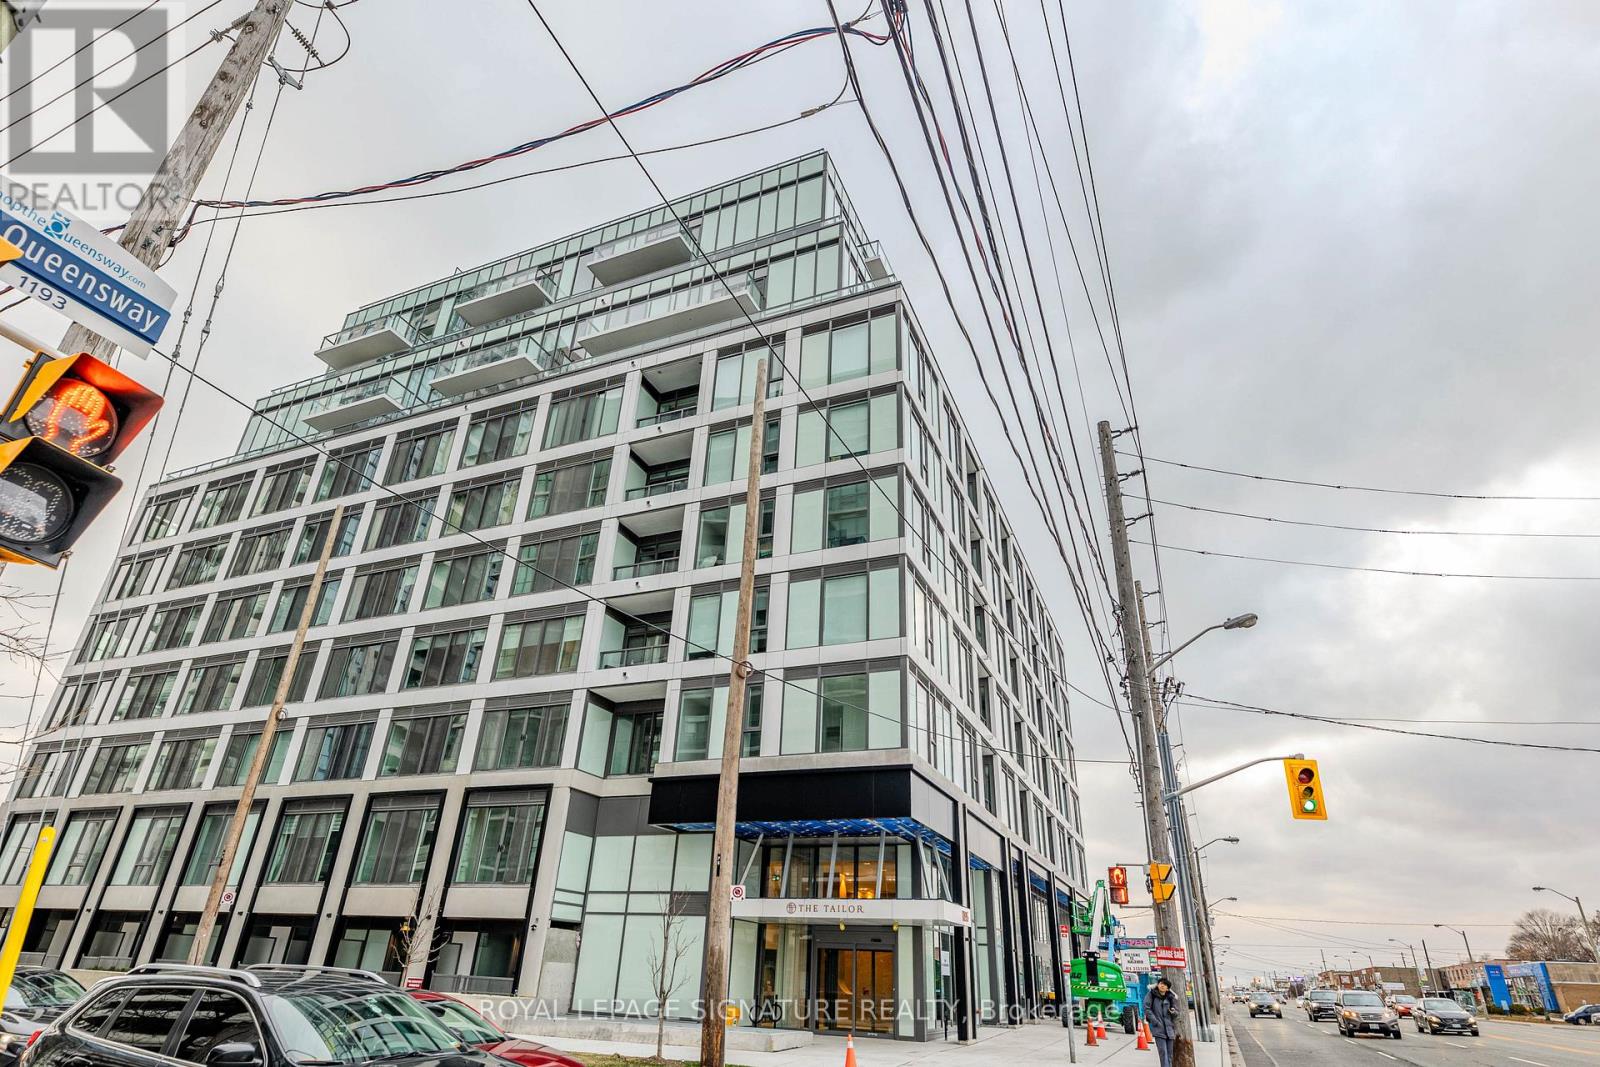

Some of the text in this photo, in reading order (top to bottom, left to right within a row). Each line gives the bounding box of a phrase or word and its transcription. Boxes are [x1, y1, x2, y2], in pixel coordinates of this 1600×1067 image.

[3, 224, 161, 333] Queensway
[18, 275, 68, 310] 1193
[799, 904, 864, 913] THE TAILOR
